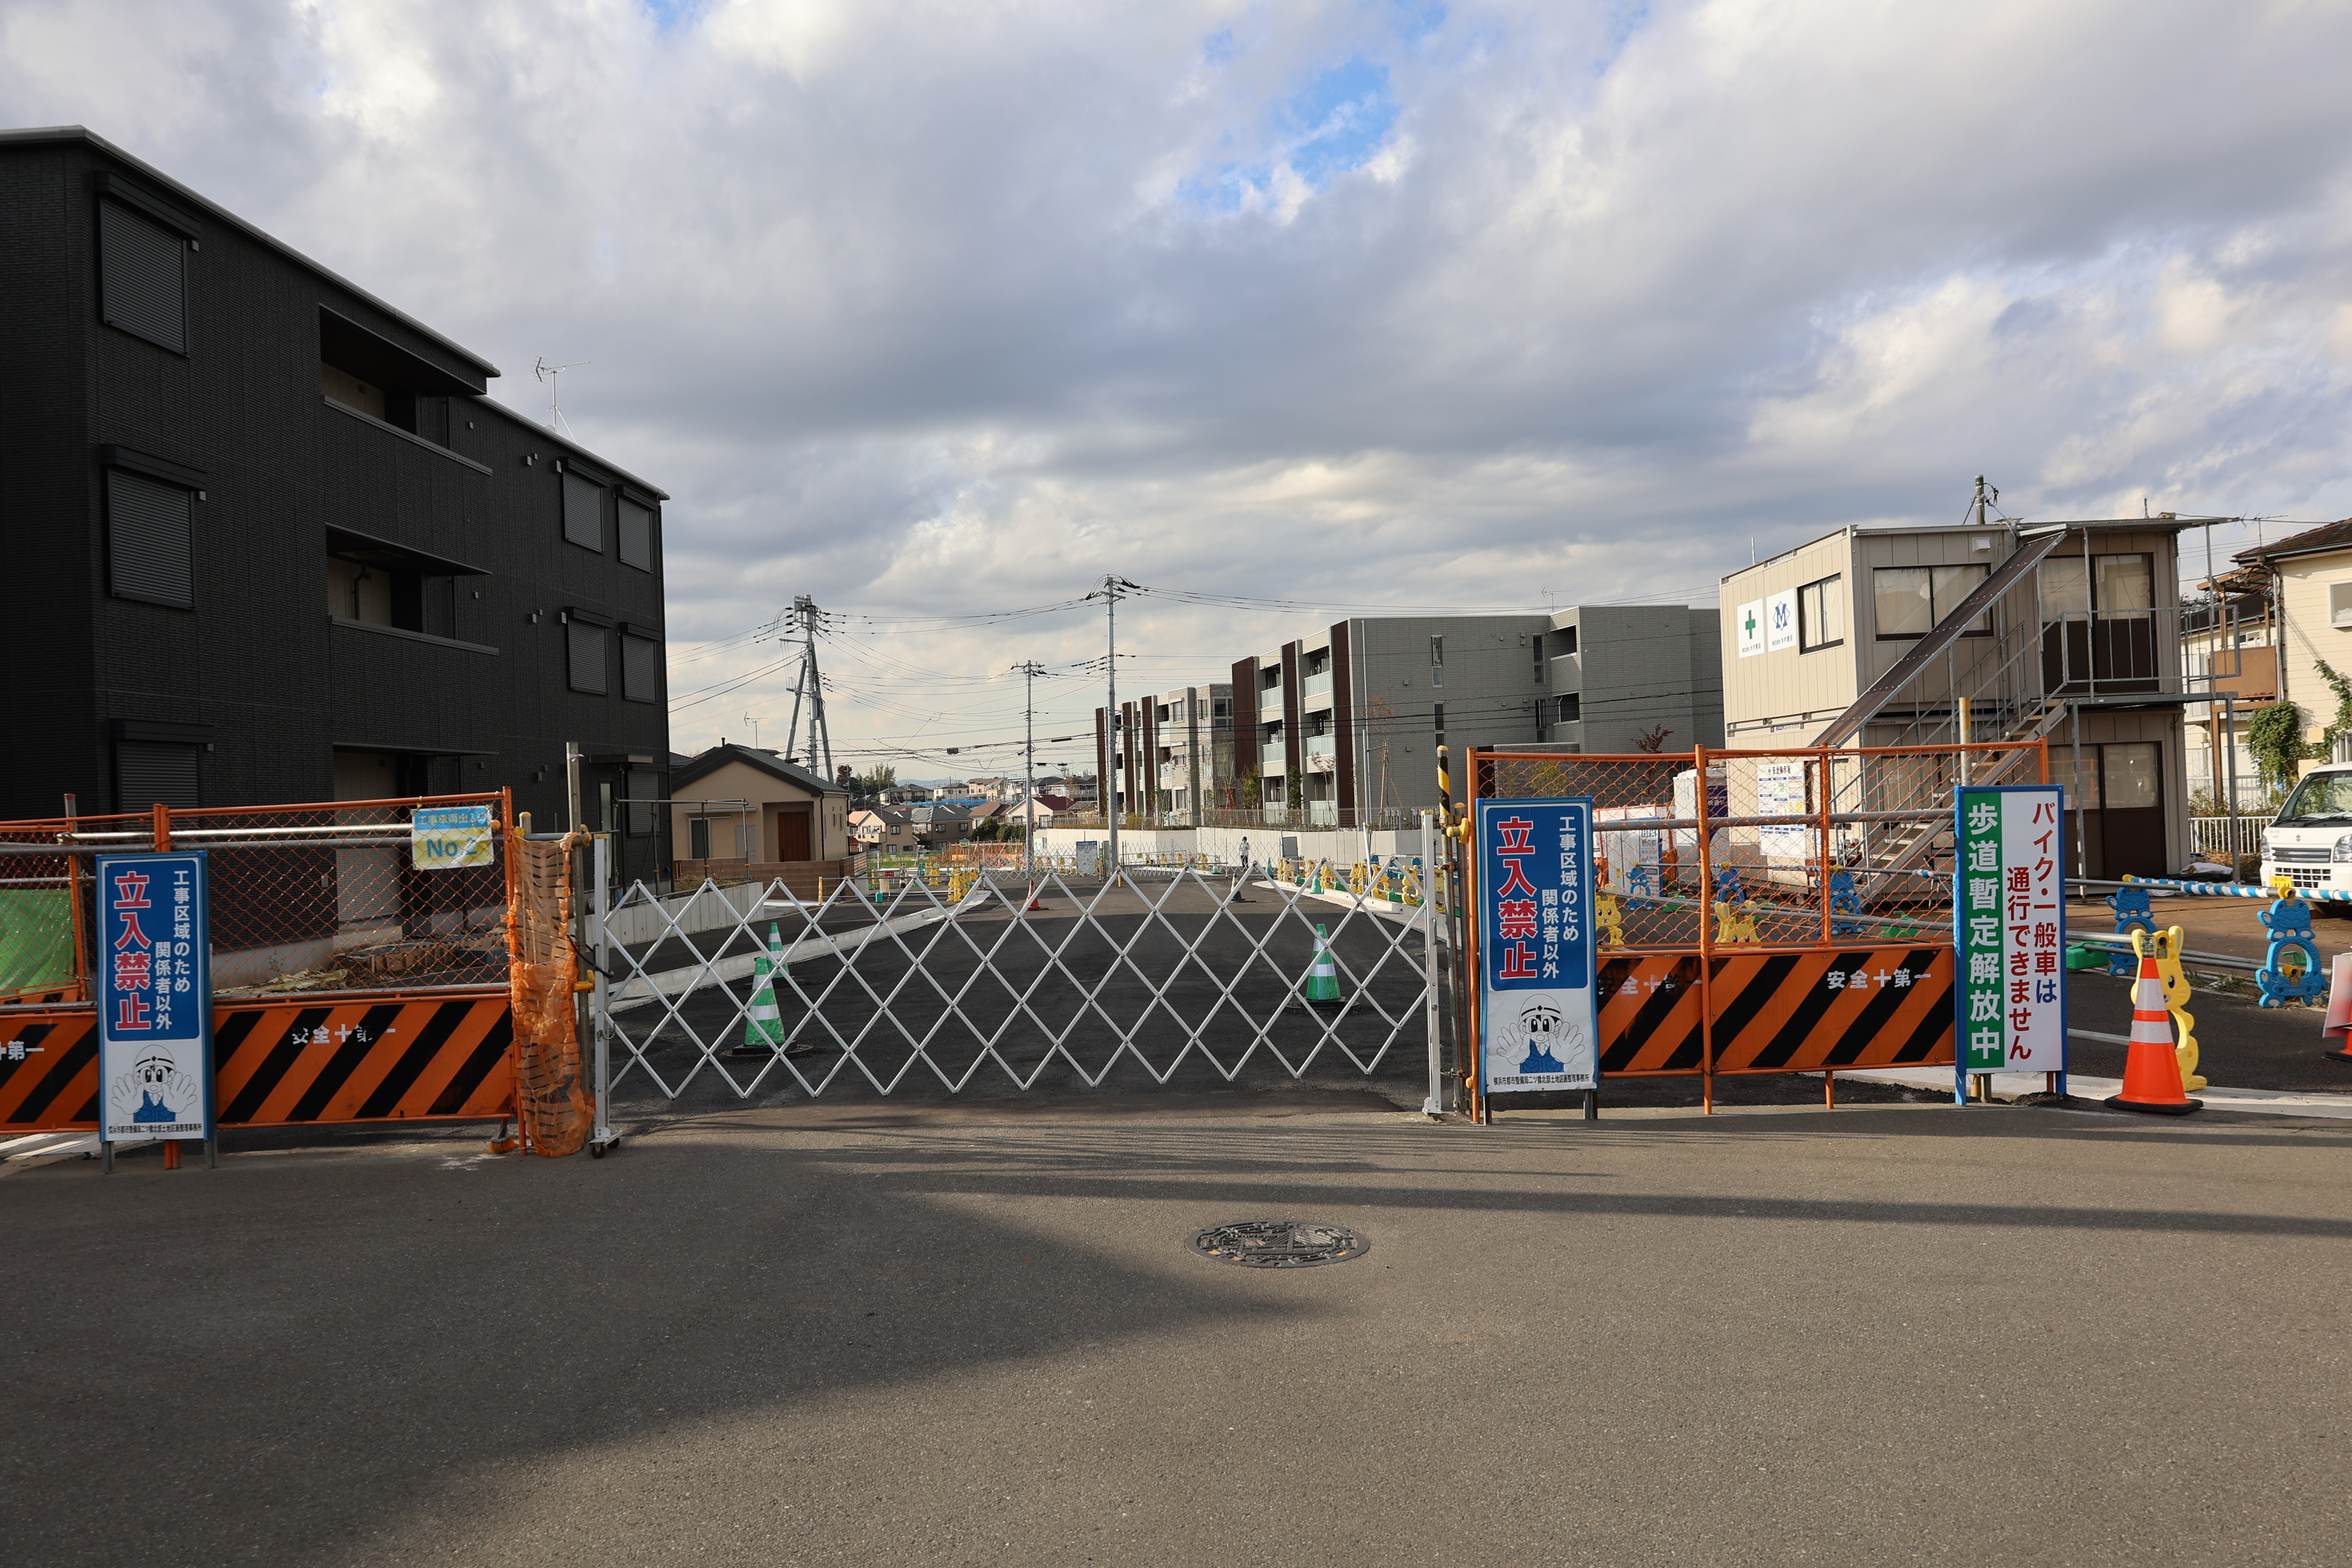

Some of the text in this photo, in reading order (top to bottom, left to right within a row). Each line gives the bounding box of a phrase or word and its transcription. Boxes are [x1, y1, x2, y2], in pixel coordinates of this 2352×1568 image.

[418, 813, 487, 824] 工事車両出入口
[1559, 816, 1579, 942] 工事区域のため
[114, 871, 152, 1030] 立入禁止
[174, 870, 190, 992] 工事区域のため
[1497, 816, 1538, 980] 立入禁止
[1542, 889, 1559, 979] 関係者以外
[1968, 802, 2001, 1060] 歩道暫定解放中
[2007, 867, 2032, 1061] 通行できません
[2032, 802, 2058, 1004] バイク・一般車は
[155, 942, 172, 1029] 関係者以外
